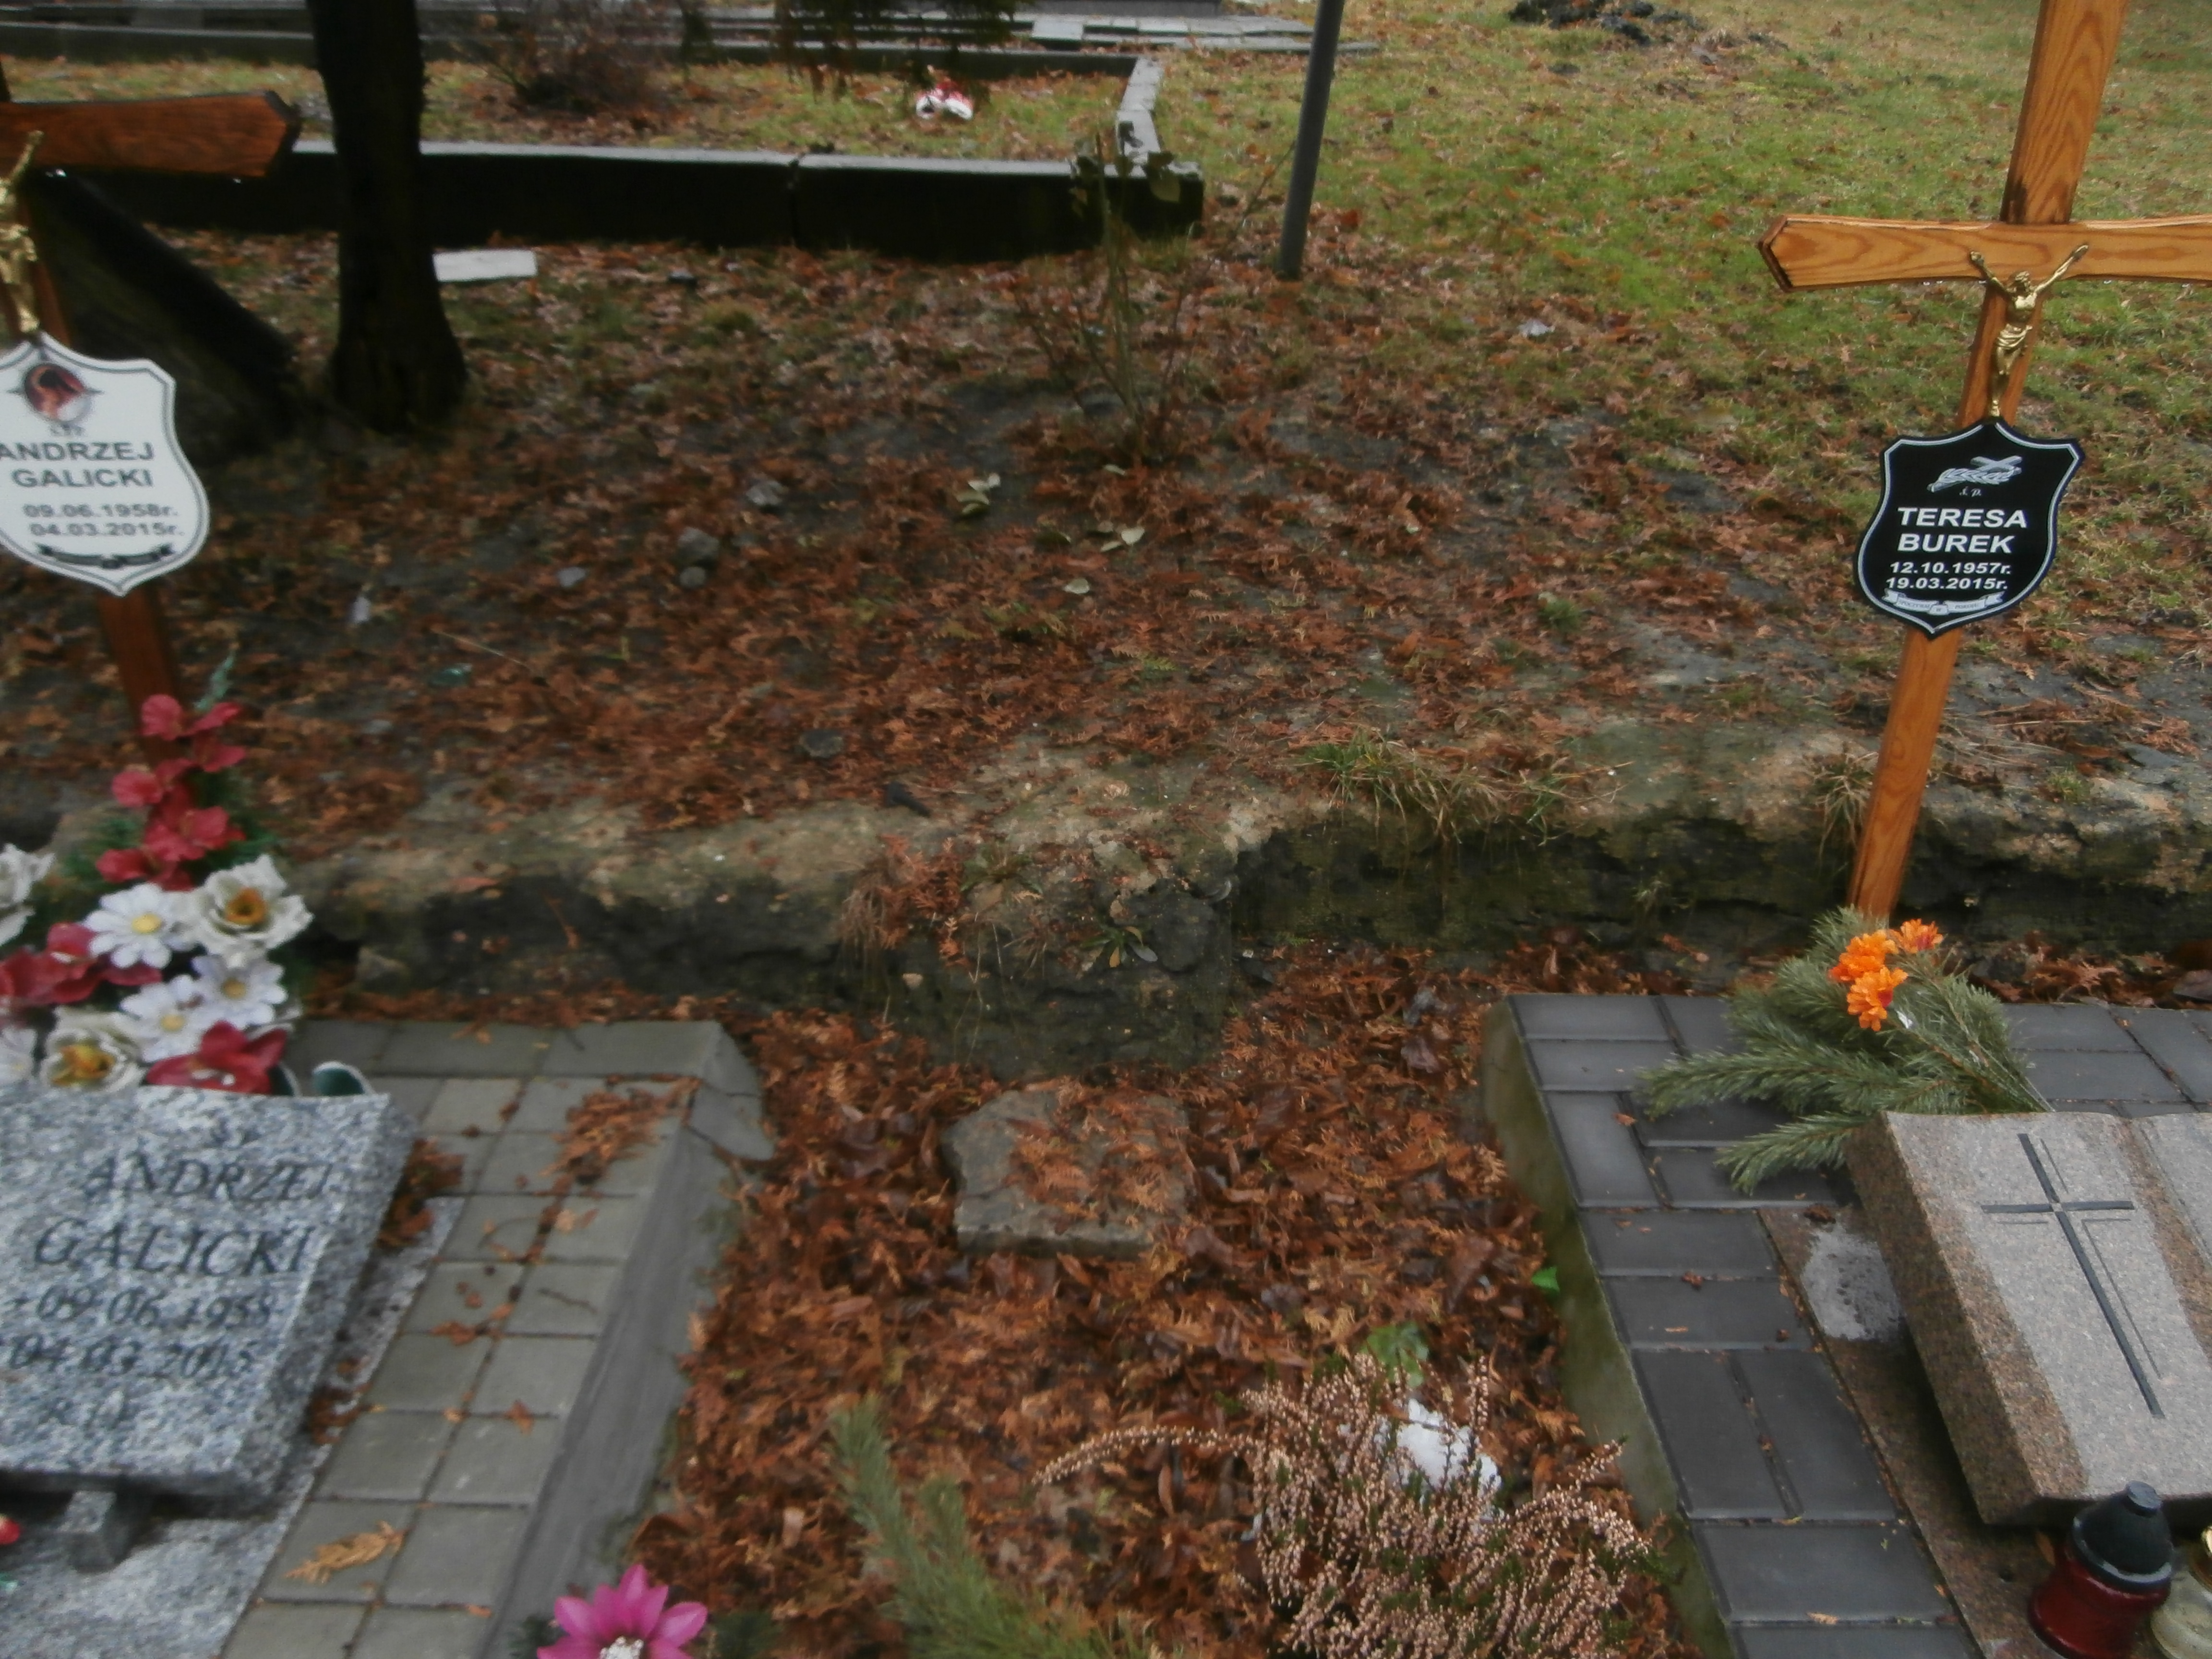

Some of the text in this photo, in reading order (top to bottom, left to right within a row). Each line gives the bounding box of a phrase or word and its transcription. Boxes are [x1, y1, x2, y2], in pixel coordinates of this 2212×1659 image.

[0, 442, 154, 460] ANDRZEJ
[12, 469, 154, 487] GALICKI
[1897, 507, 2028, 528] TERESA
[1897, 533, 2015, 553] BUREK
[1886, 577, 2008, 589] 19.03.2015r.
[33, 1217, 314, 1276] GALICKI
